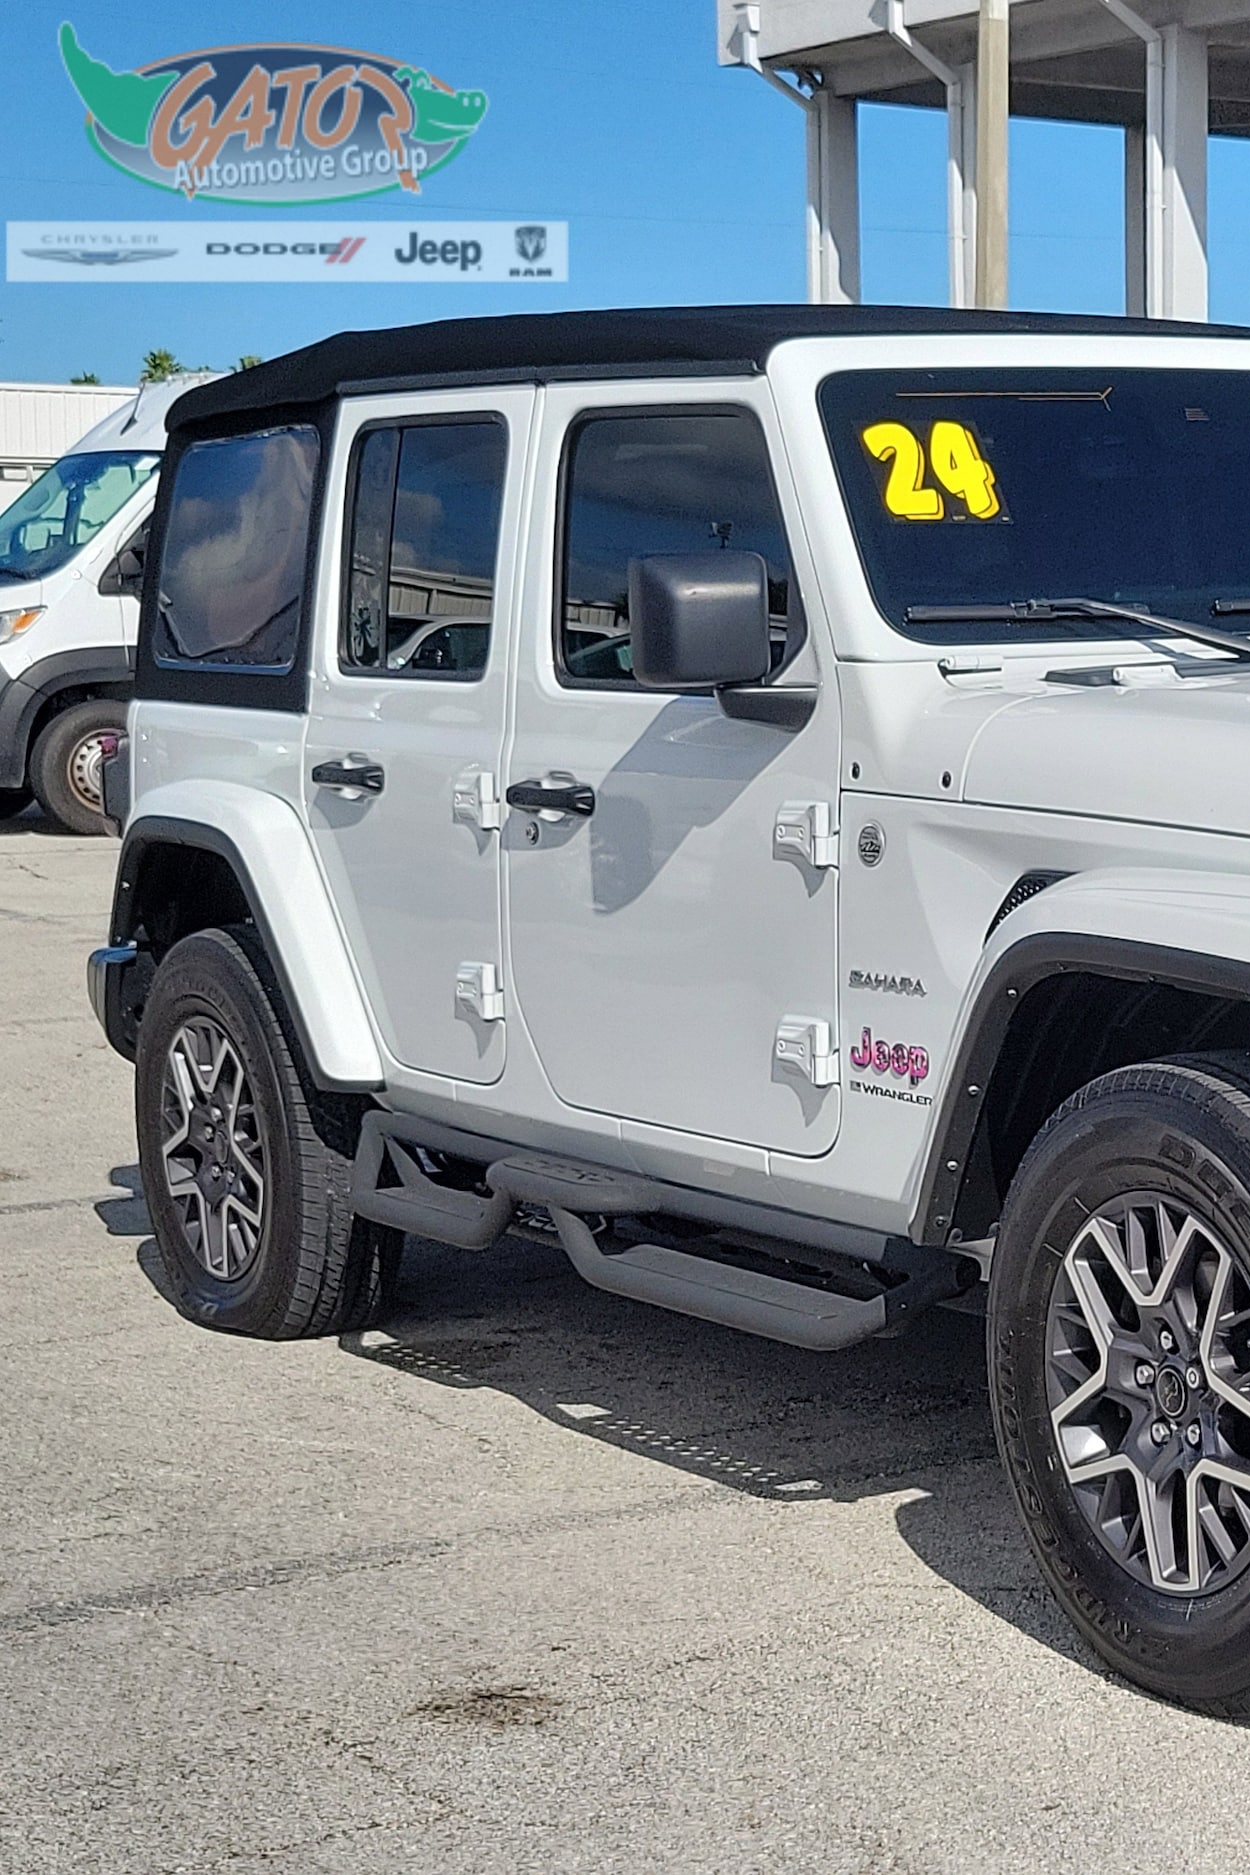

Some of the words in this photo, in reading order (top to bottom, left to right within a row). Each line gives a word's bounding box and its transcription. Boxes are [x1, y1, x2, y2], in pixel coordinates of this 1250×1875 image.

[861, 418, 1001, 521] 24
[849, 970, 926, 996] SAHARA
[850, 1027, 928, 1084] Jeep
[862, 1083, 932, 1106] WRANGLER
